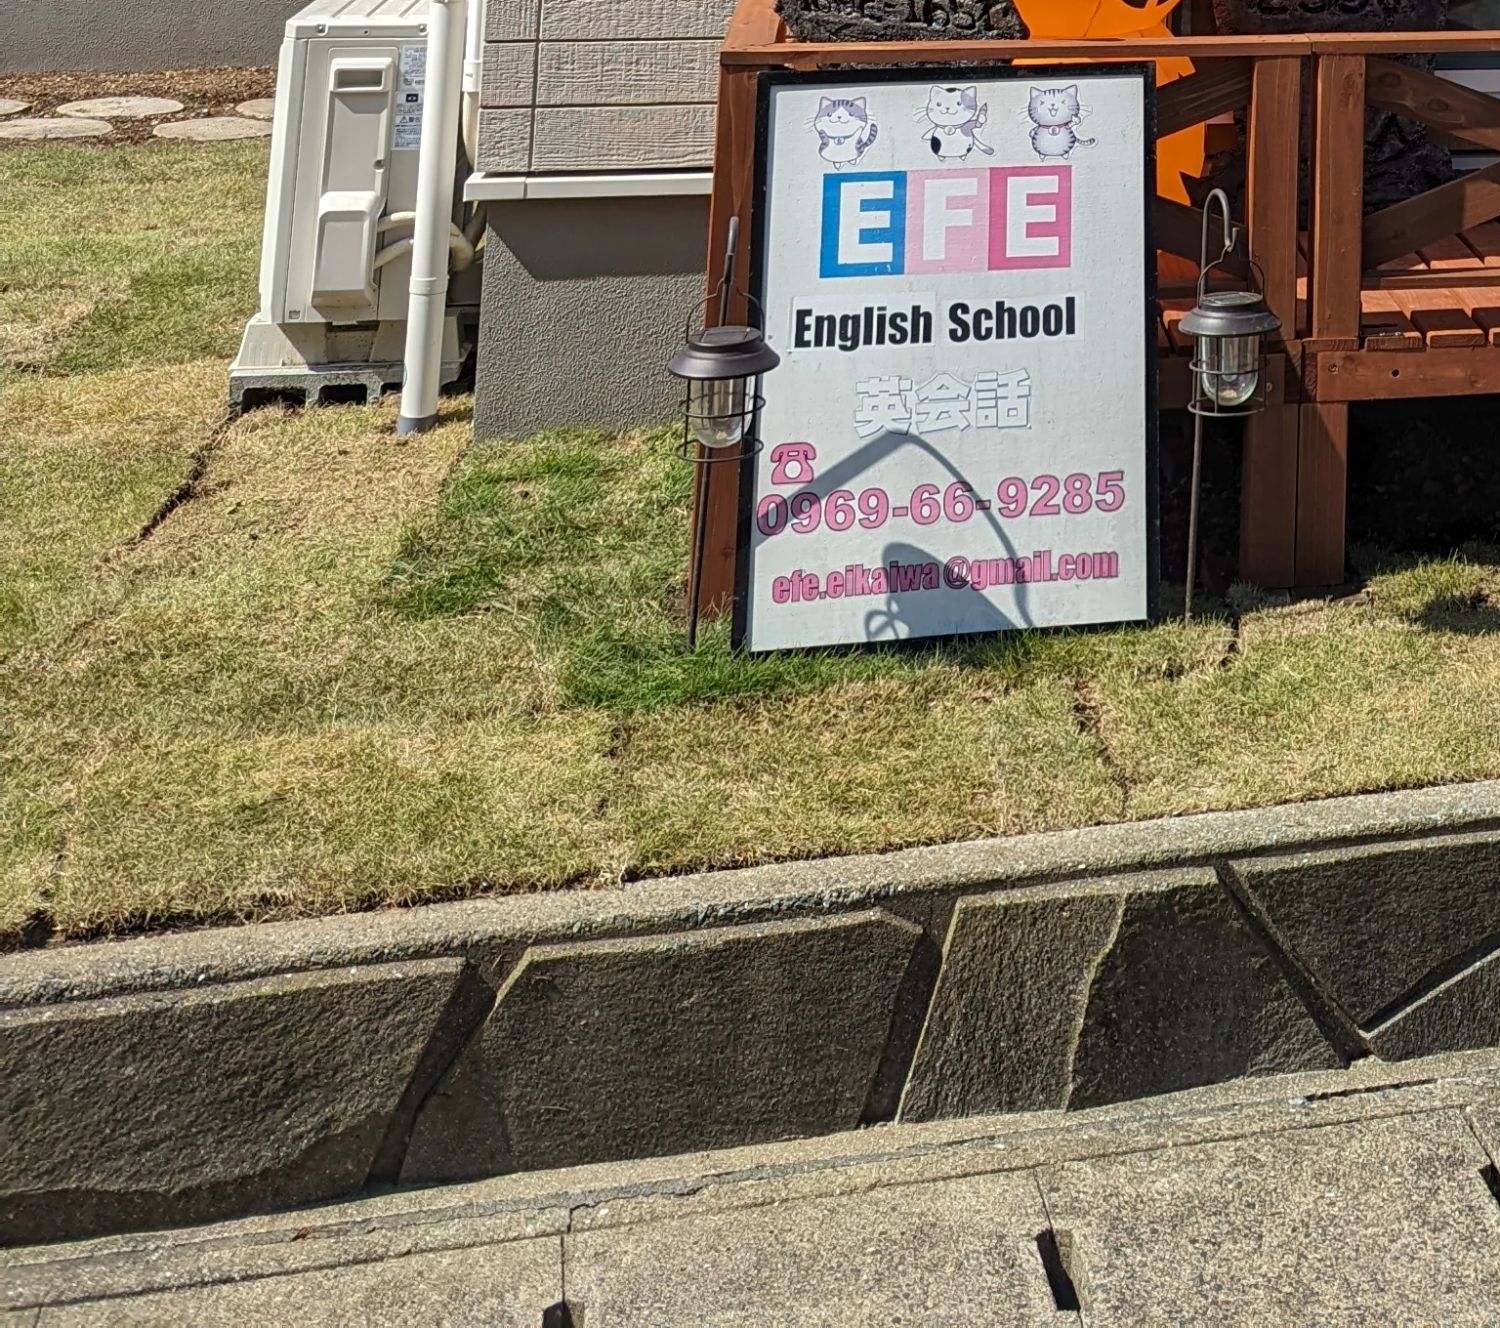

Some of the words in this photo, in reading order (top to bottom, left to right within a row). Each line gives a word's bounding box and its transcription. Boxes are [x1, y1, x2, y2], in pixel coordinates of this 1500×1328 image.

[838, 175, 1059, 265] EFE
[794, 305, 933, 351] English
[948, 297, 1076, 342] School
[854, 368, 1031, 438] 英会話
[757, 471, 1125, 536] 0969-66-9285
